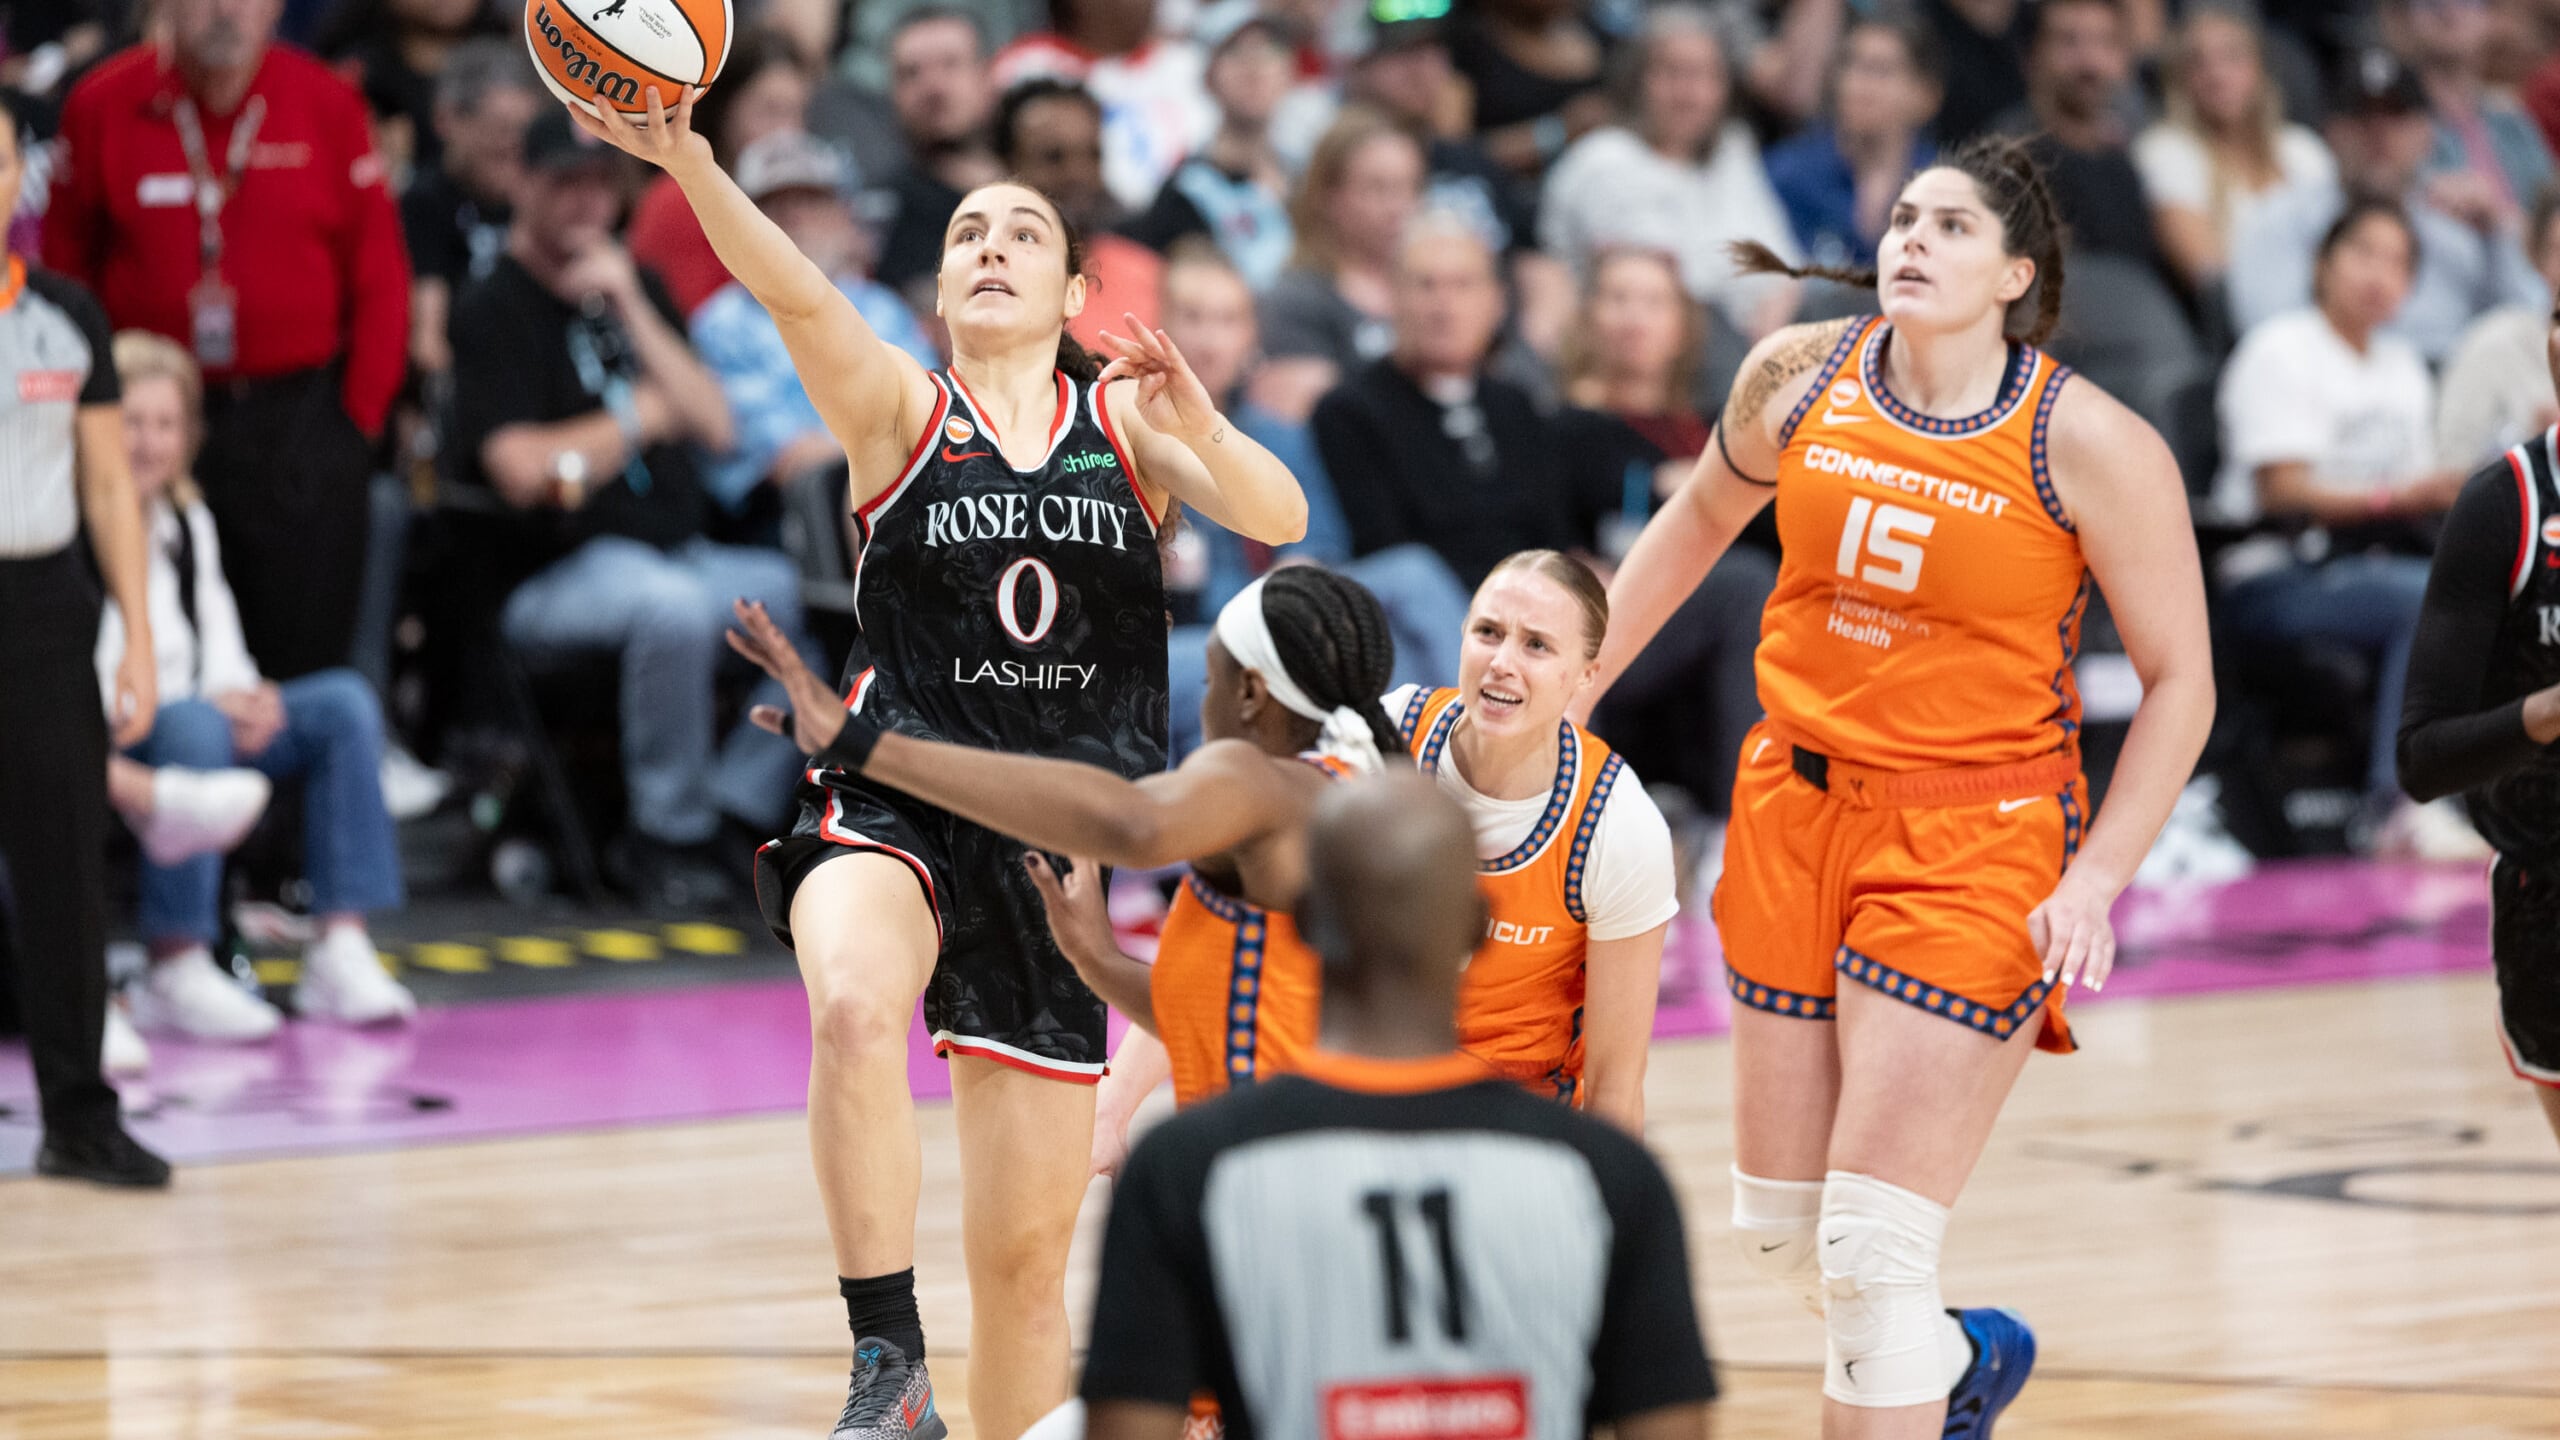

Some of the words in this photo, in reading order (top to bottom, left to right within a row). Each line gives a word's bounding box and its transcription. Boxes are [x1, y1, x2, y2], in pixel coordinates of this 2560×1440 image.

[535, 2, 639, 105] Wilson
[1063, 450, 1117, 474] chime
[1803, 443, 2011, 518] CONNECTICUT
[924, 494, 1029, 548] ROSE
[1039, 494, 1128, 551] CITY
[1836, 496, 1937, 593] 15
[997, 556, 1059, 644] 0
[1827, 612, 1892, 650] Health
[1832, 597, 1930, 638] NewHavn
[954, 657, 1097, 689] LASHIFY
[1359, 1189, 1469, 1347] 11
